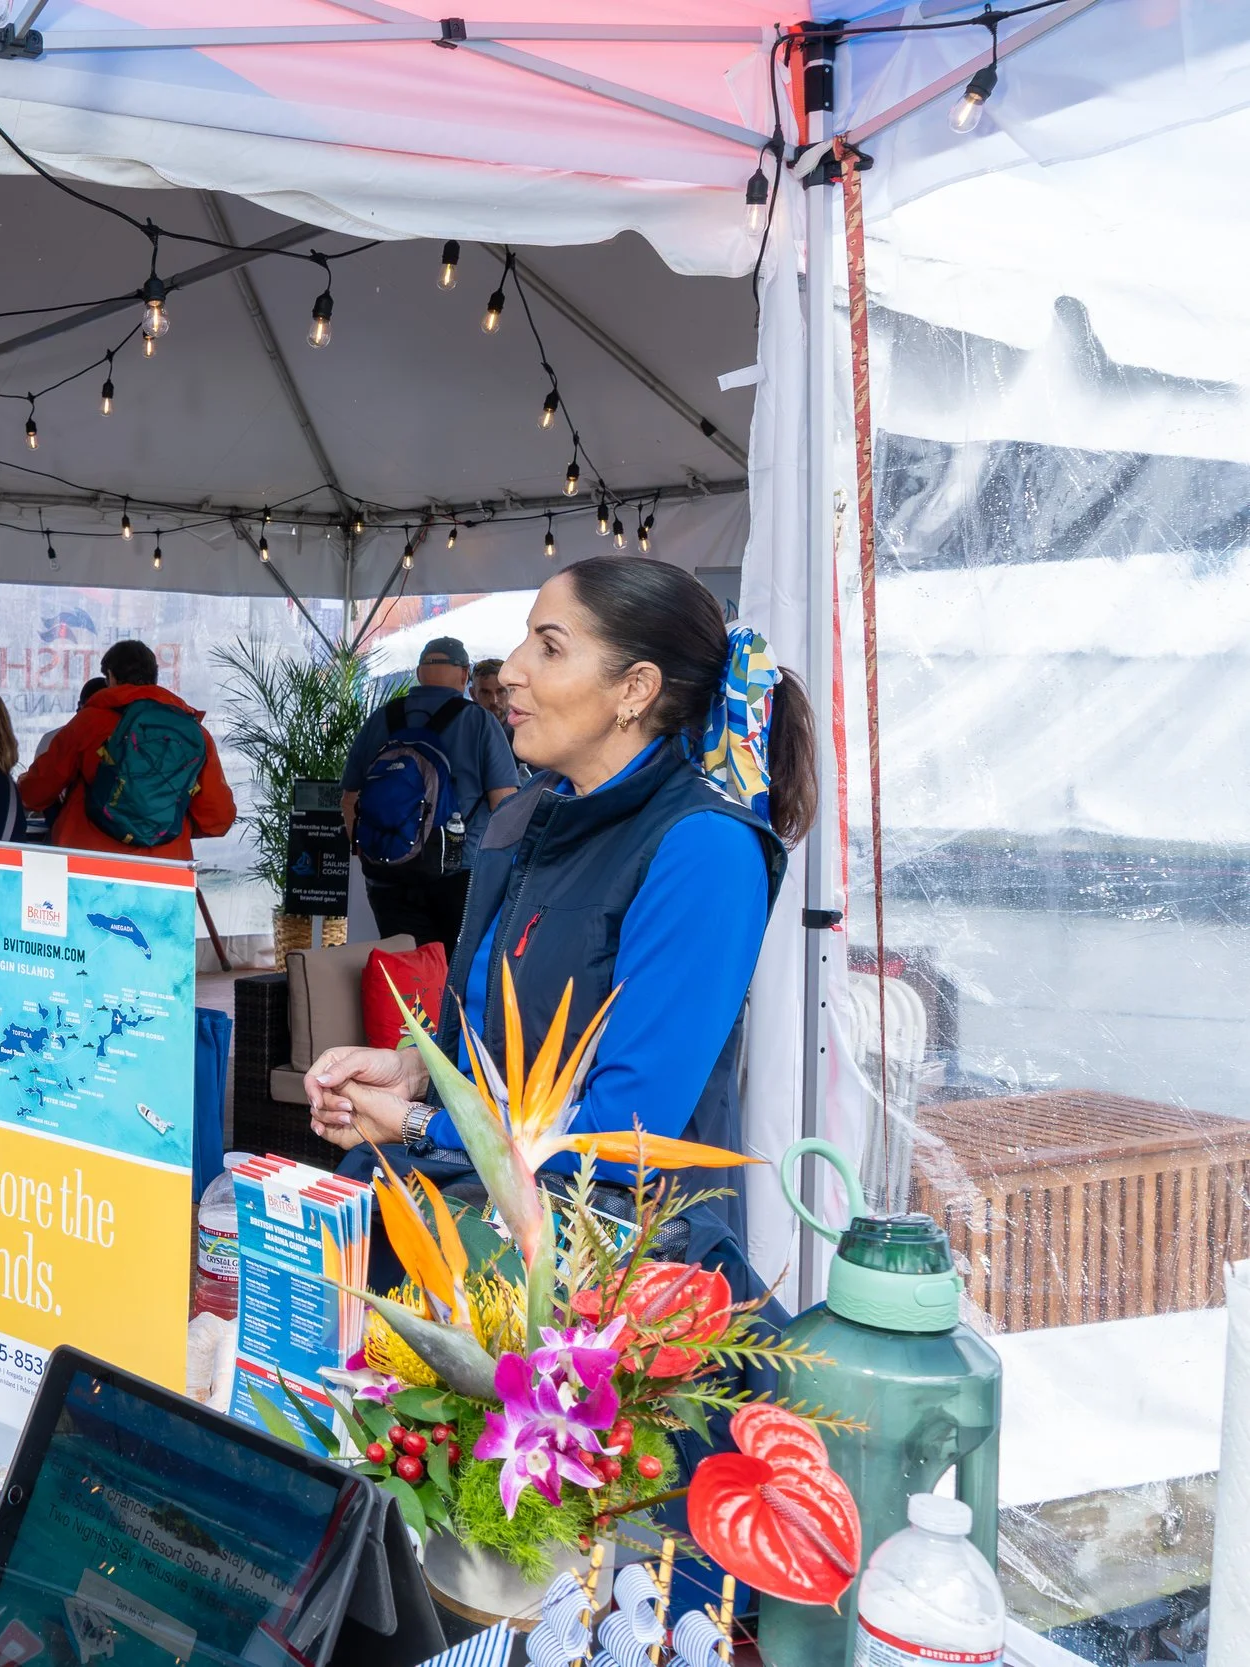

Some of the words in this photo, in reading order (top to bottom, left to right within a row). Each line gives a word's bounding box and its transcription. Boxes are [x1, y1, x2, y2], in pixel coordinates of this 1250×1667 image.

[322, 868, 348, 876] COACH
[28, 906, 60, 922] BRITISH
[110, 924, 133, 932] ANEGADA
[4, 937, 85, 963] BVITOURISM.COM
[18, 964, 54, 979] ISLANDS
[12, 1030, 32, 1038] TORTOLA
[0, 1046, 13, 1054] Road
[60, 1168, 115, 1248] the
[268, 1194, 298, 1214] BRITISH
[250, 1216, 274, 1232] BRITISH
[274, 1225, 294, 1239] VIRGIN
[295, 1232, 322, 1249] ISLANDS
[265, 1232, 288, 1247] MARINA
[289, 1241, 308, 1254] GUIDE
[285, 1380, 302, 1393] GORDA
[48, 1503, 74, 1526] Two
[72, 1517, 108, 1548] Nights
[110, 1538, 136, 1564] Stay
[138, 1552, 188, 1592] inclusive
[106, 1488, 148, 1518] chance
[221, 1548, 248, 1573] stay
[250, 1561, 268, 1582] for
[271, 1577, 296, 1596] two
[74, 1492, 106, 1520] Scrub
[143, 1530, 183, 1563] Resort
[183, 1552, 209, 1578] Spa
[211, 1567, 222, 1583] &
[224, 1573, 268, 1611] Marina
[920, 1648, 960, 1661] BOTTLED
[964, 1654, 976, 1662] AT
